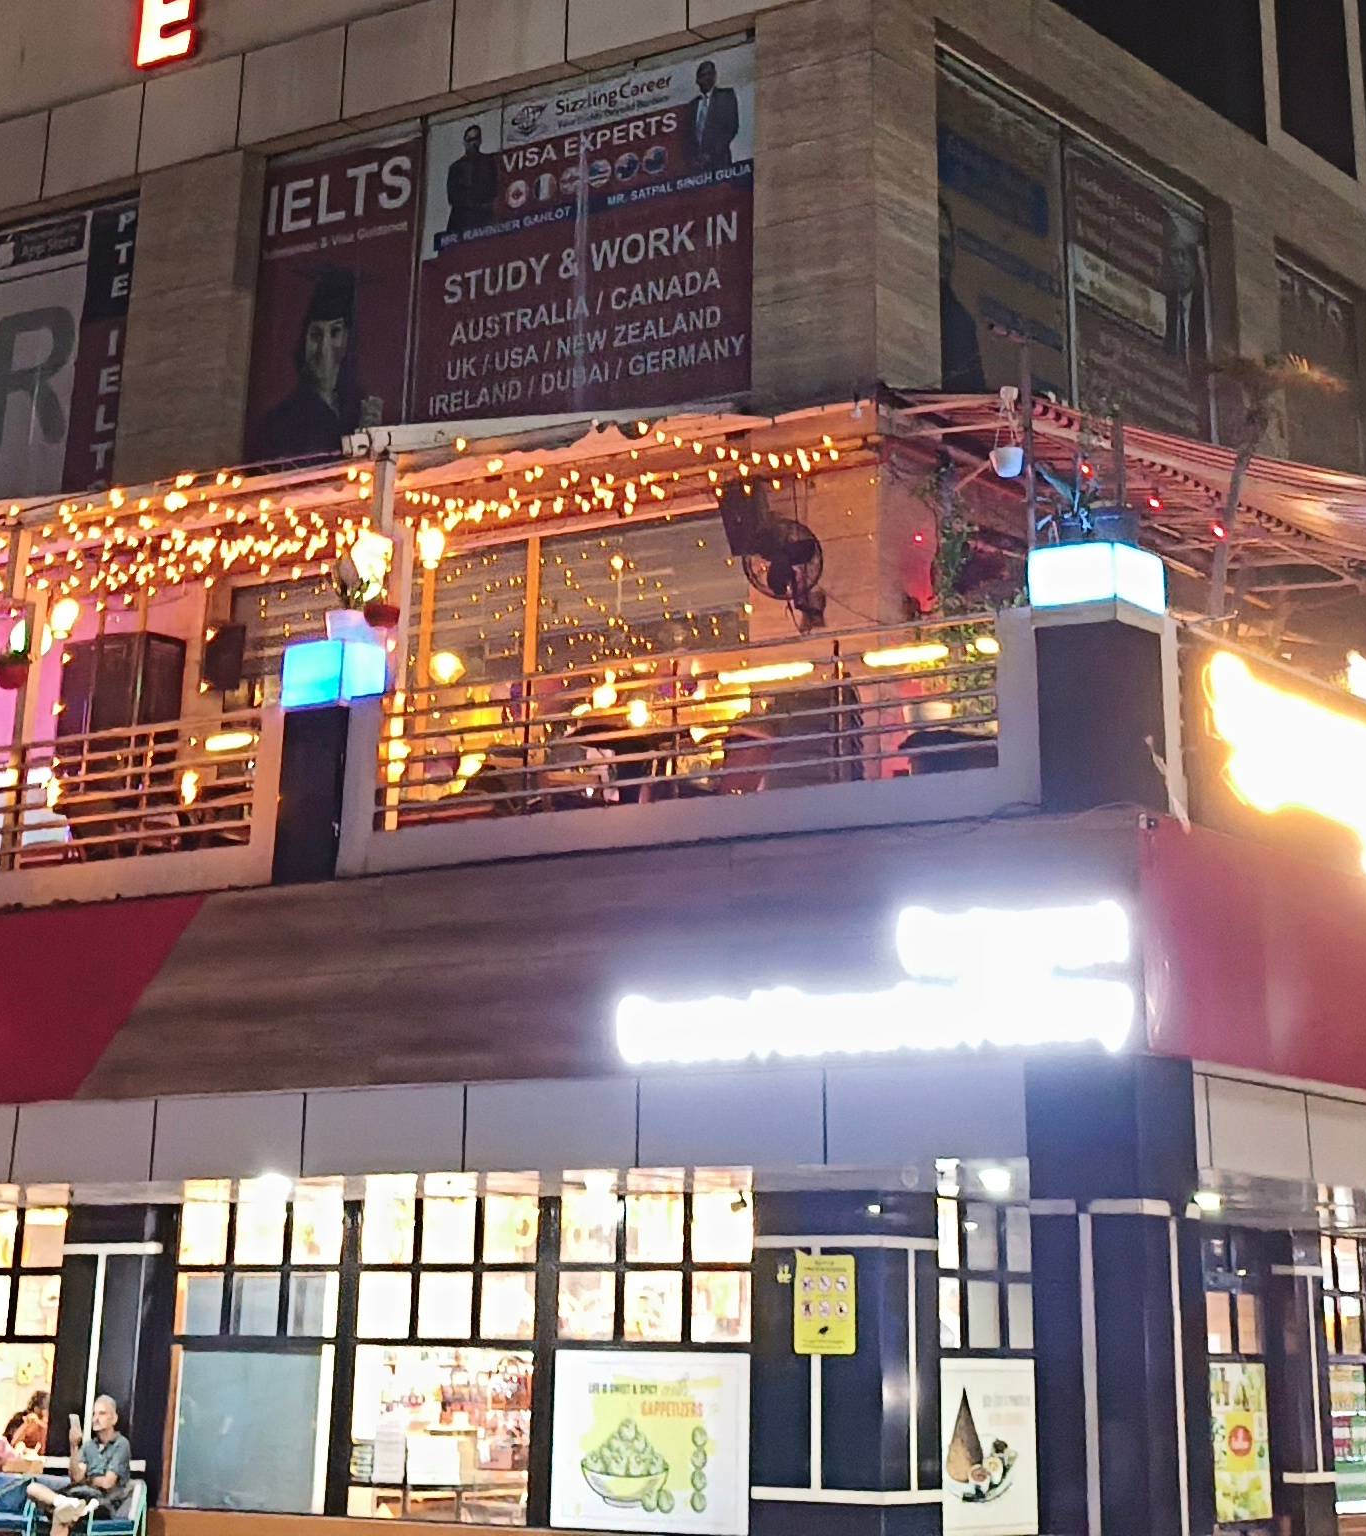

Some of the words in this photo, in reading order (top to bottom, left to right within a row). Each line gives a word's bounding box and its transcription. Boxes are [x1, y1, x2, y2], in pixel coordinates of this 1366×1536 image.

[503, 144, 557, 173] VISA
[564, 112, 678, 158] EXPERTS
[266, 155, 412, 237] IELTS
[110, 213, 136, 299] PTE
[443, 253, 550, 305] STUDY
[558, 247, 579, 280] &
[590, 220, 696, 273] WORK
[705, 211, 738, 248] IN
[447, 356, 476, 381] UK
[494, 345, 538, 372] USA
[556, 328, 608, 358] NEW
[613, 305, 721, 348] ZEALAND
[450, 295, 590, 347] AUSTRALIA
[611, 267, 722, 311] CANADA
[428, 379, 522, 417] IRELAND
[541, 360, 609, 395] DUBAI
[628, 333, 746, 377] GERMANY
